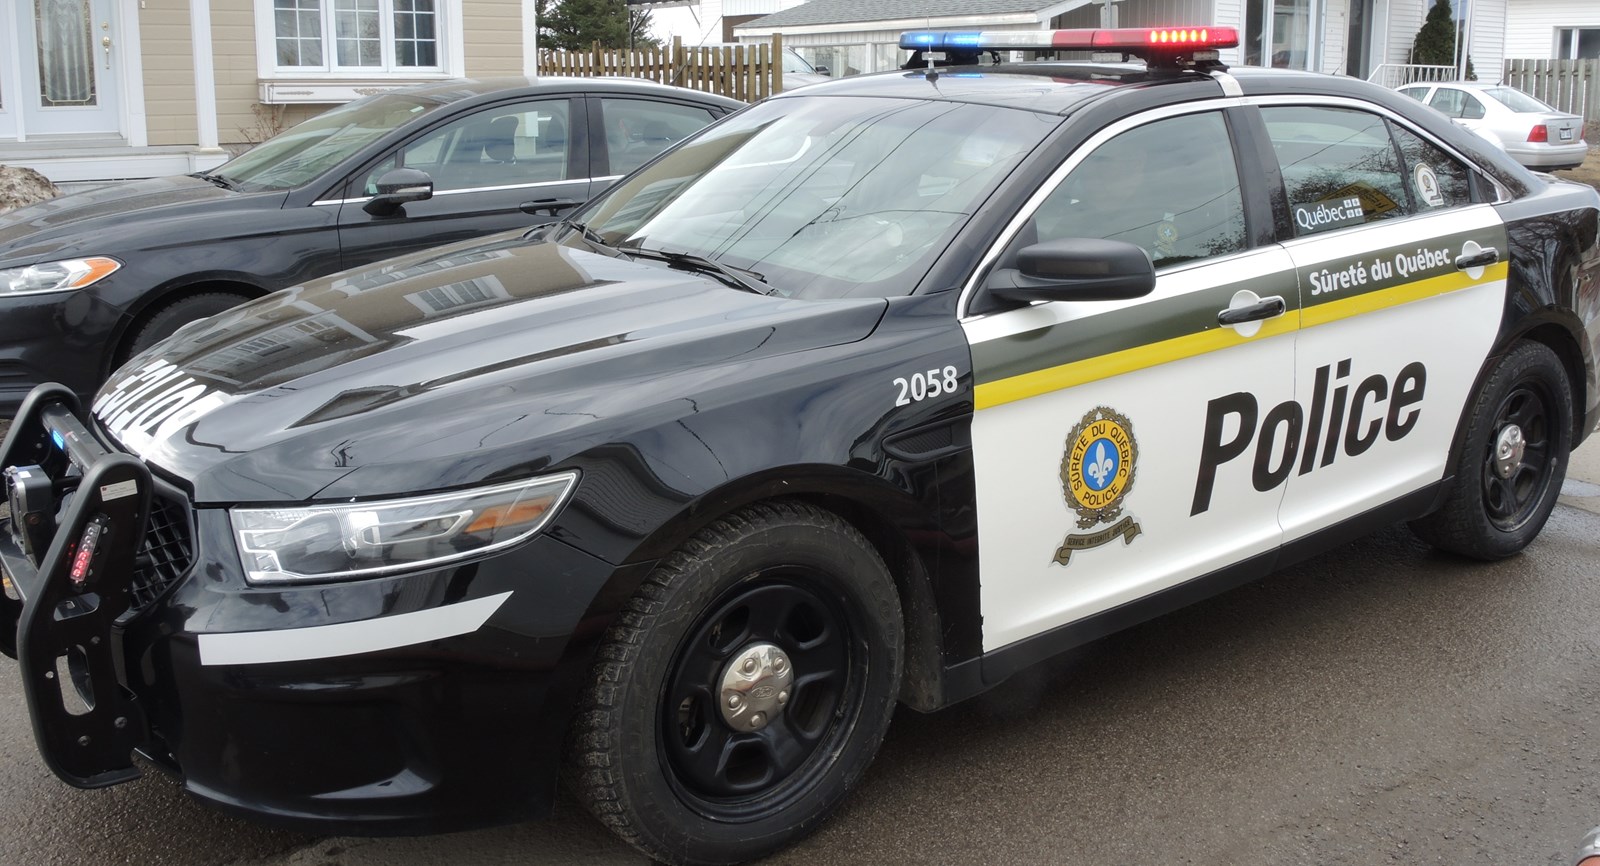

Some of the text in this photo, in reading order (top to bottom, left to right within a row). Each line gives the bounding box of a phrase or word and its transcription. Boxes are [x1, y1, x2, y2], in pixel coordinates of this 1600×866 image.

[1296, 205, 1346, 230] Québec
[1309, 248, 1451, 296] Sûreté du Québec
[893, 365, 958, 407] 2058
[1091, 423, 1106, 437] DU
[1190, 358, 1427, 517] Police
[1082, 484, 1119, 506] POLICE
